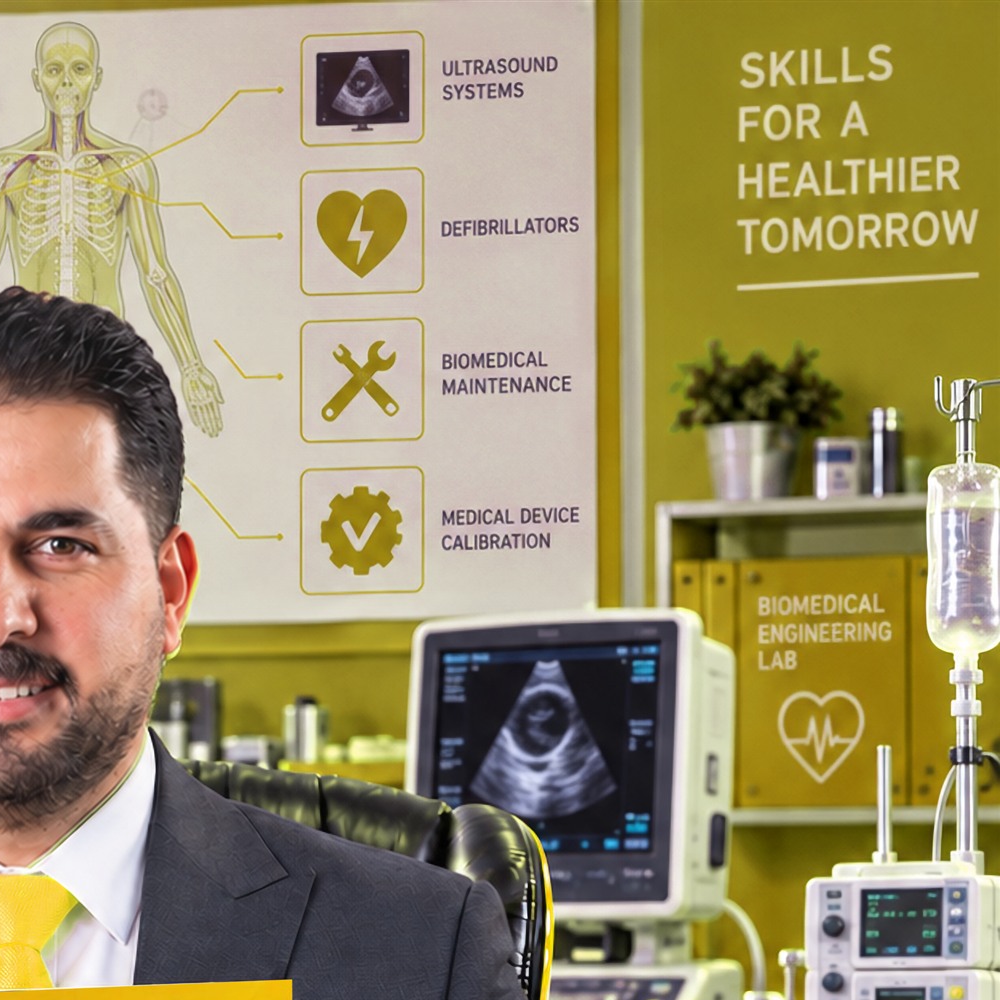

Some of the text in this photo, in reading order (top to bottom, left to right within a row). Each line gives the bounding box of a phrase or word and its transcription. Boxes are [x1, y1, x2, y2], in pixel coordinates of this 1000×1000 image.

[442, 55, 559, 77] ULTRASOUND
[739, 44, 893, 89] SKILLS
[442, 81, 525, 101] SYSTEMS
[738, 100, 869, 143] FOR A
[738, 154, 960, 200] HEALTHIER
[441, 216, 580, 238] DEFIBRILLATORS
[736, 208, 979, 255] TOMORROW
[442, 350, 549, 370] BIOMEDICAL
[442, 375, 572, 396] MAINTENANCE
[441, 506, 580, 527] MEDICAL DEVICE
[441, 532, 551, 551] CALIBRATION
[757, 593, 885, 617] BIOMEDICAL
[757, 621, 893, 645] ENGINEERING
[758, 649, 798, 671] LAB
